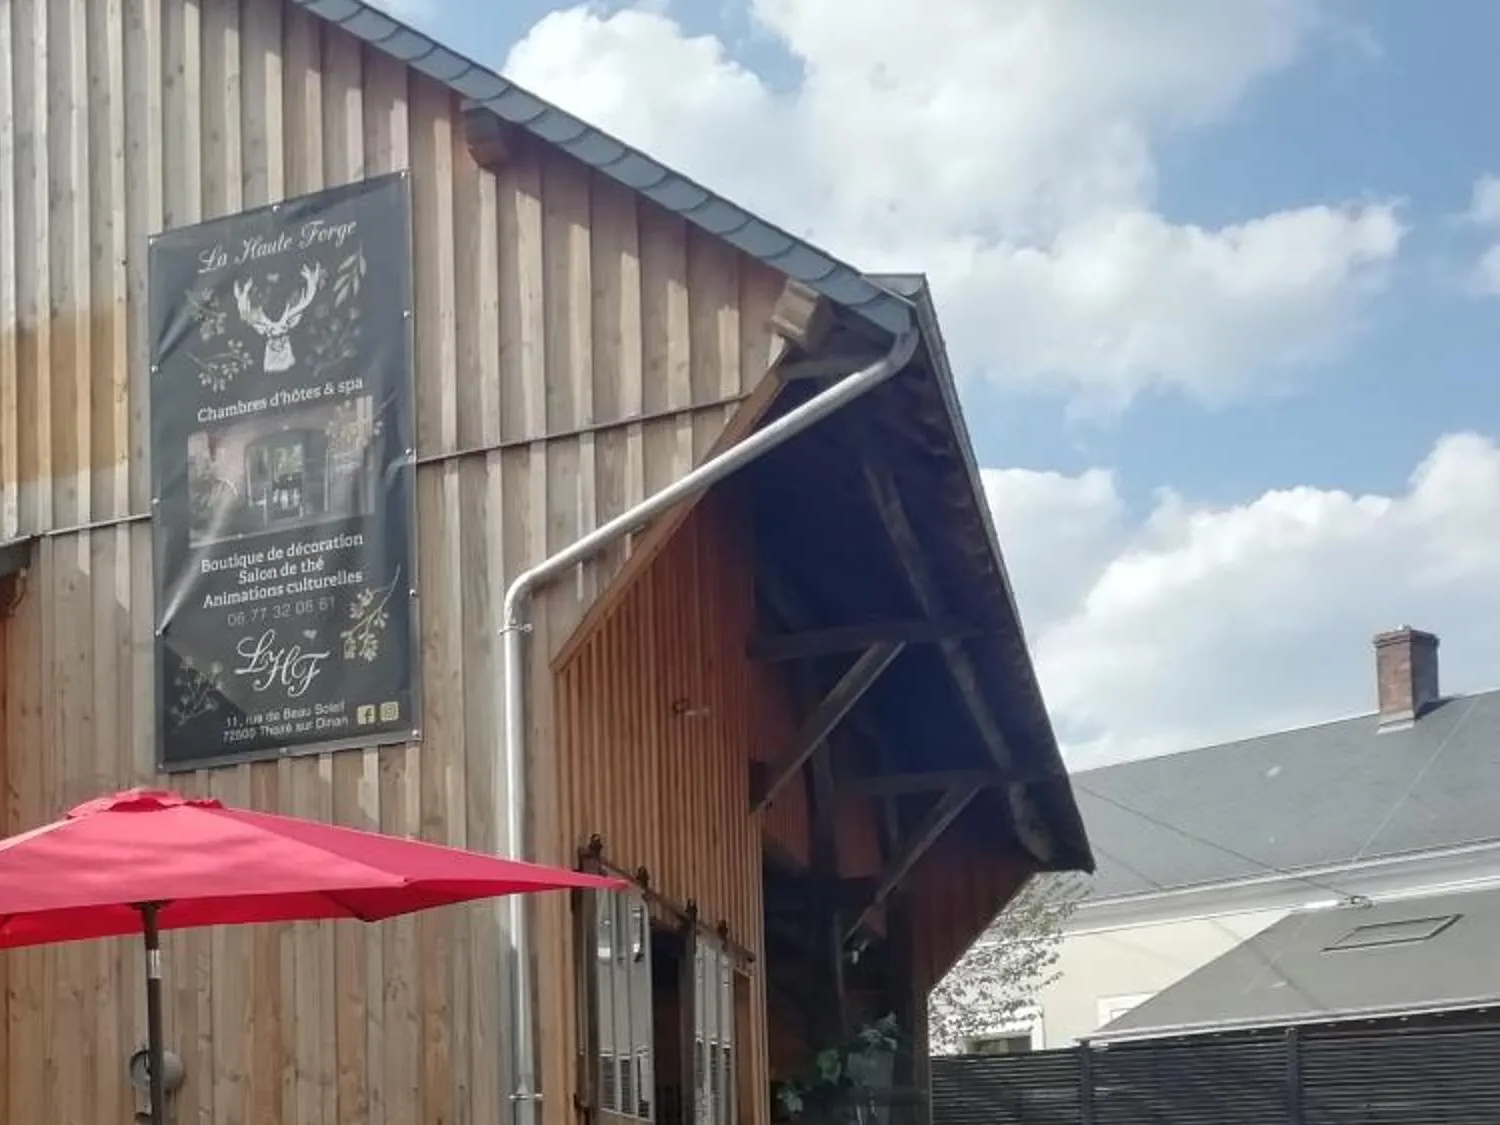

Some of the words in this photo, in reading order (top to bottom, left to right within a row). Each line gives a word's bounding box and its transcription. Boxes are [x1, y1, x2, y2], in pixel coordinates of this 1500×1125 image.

[198, 244, 228, 274] La
[235, 231, 293, 265] Haute
[298, 220, 357, 249] Forge
[197, 400, 267, 423] Chambres
[269, 384, 321, 406] d'hôtes
[324, 383, 334, 395] &
[338, 376, 363, 394] spa
[201, 552, 264, 573] Boutique
[267, 547, 284, 561] de
[286, 532, 363, 557] décoration
[238, 568, 277, 585] Salon
[279, 562, 297, 577] de
[301, 556, 324, 573] thé
[202, 584, 284, 608] Animations
[286, 570, 363, 594] culturelles
